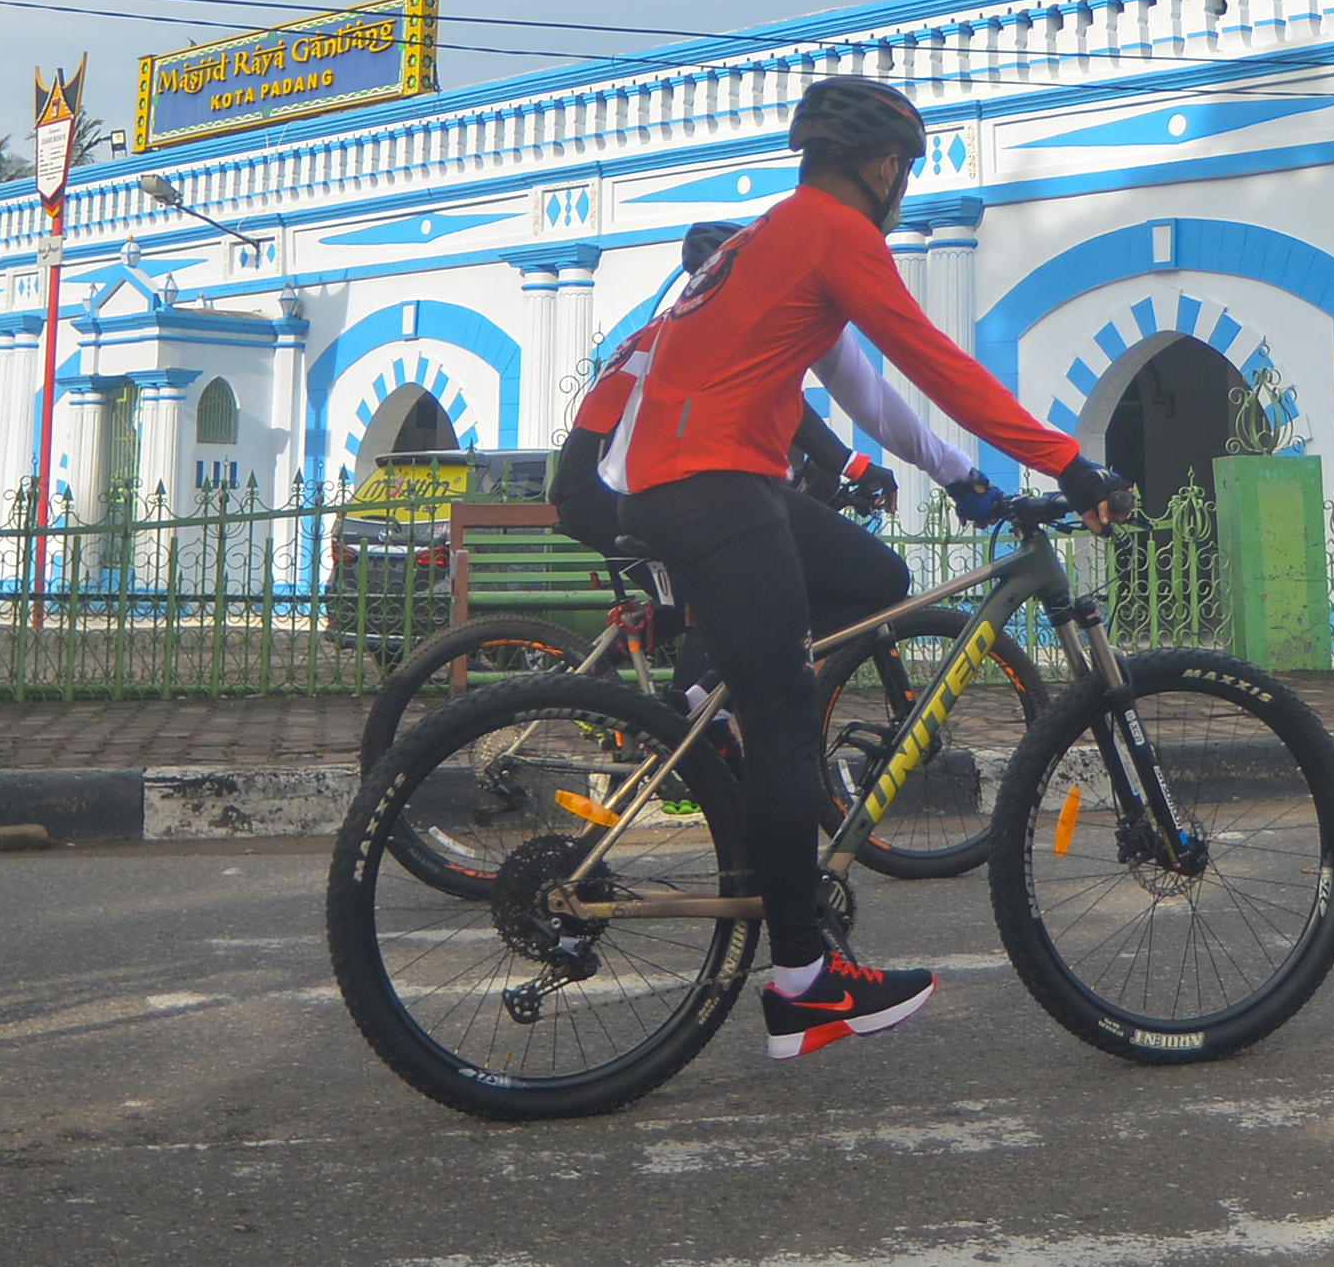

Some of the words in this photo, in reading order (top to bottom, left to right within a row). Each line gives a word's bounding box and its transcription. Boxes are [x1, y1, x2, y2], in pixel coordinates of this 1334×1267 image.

[158, 52, 229, 94] Masjid
[233, 39, 286, 76] Raya
[211, 87, 255, 111] KOTA
[261, 69, 334, 100] PADANG
[1181, 668, 1273, 703] MAXXIS
[865, 620, 996, 824] UNITED
[353, 772, 406, 883] MAXXIS
